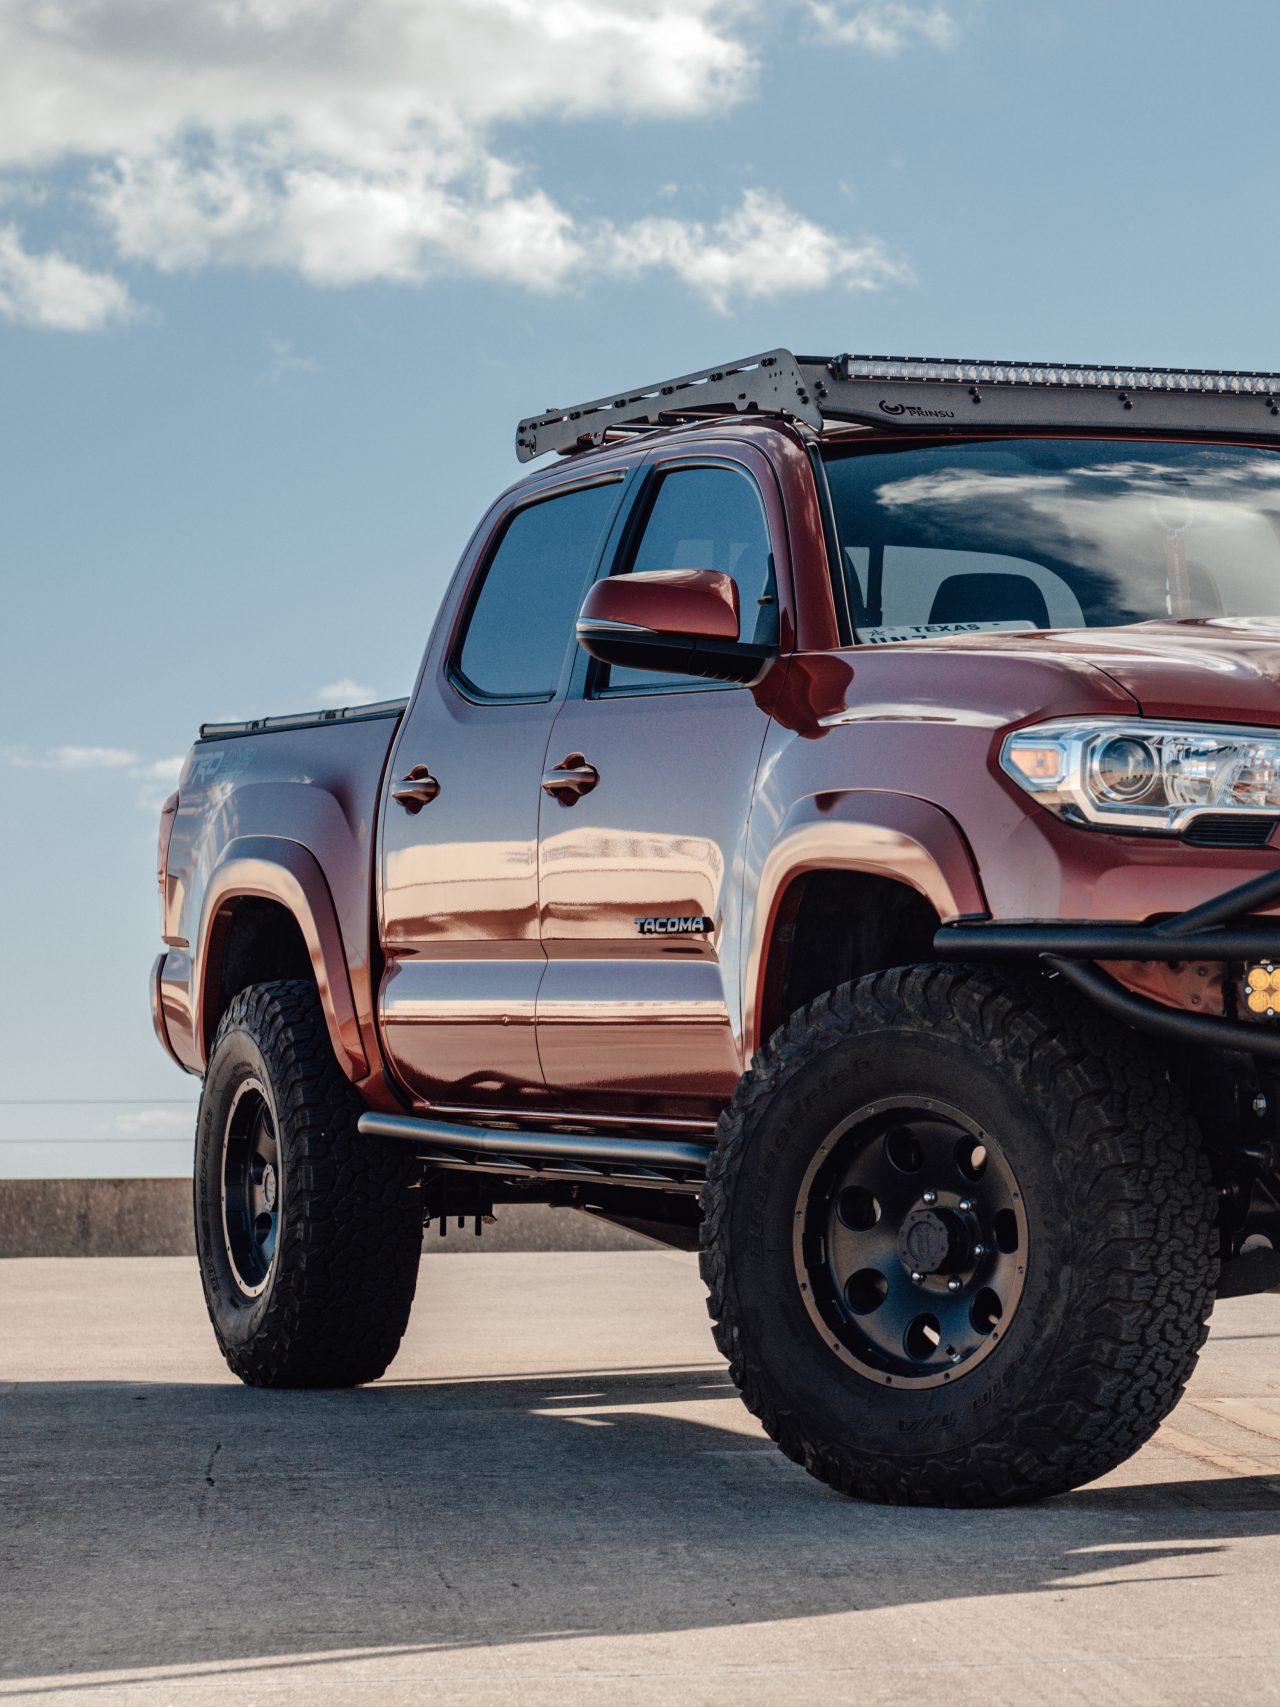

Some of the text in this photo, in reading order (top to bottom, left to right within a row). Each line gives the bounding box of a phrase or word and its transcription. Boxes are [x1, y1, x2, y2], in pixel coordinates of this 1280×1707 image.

[908, 408, 955, 418] PRINSU
[909, 623, 981, 633] TEXAS
[634, 917, 705, 933] TACOMA
